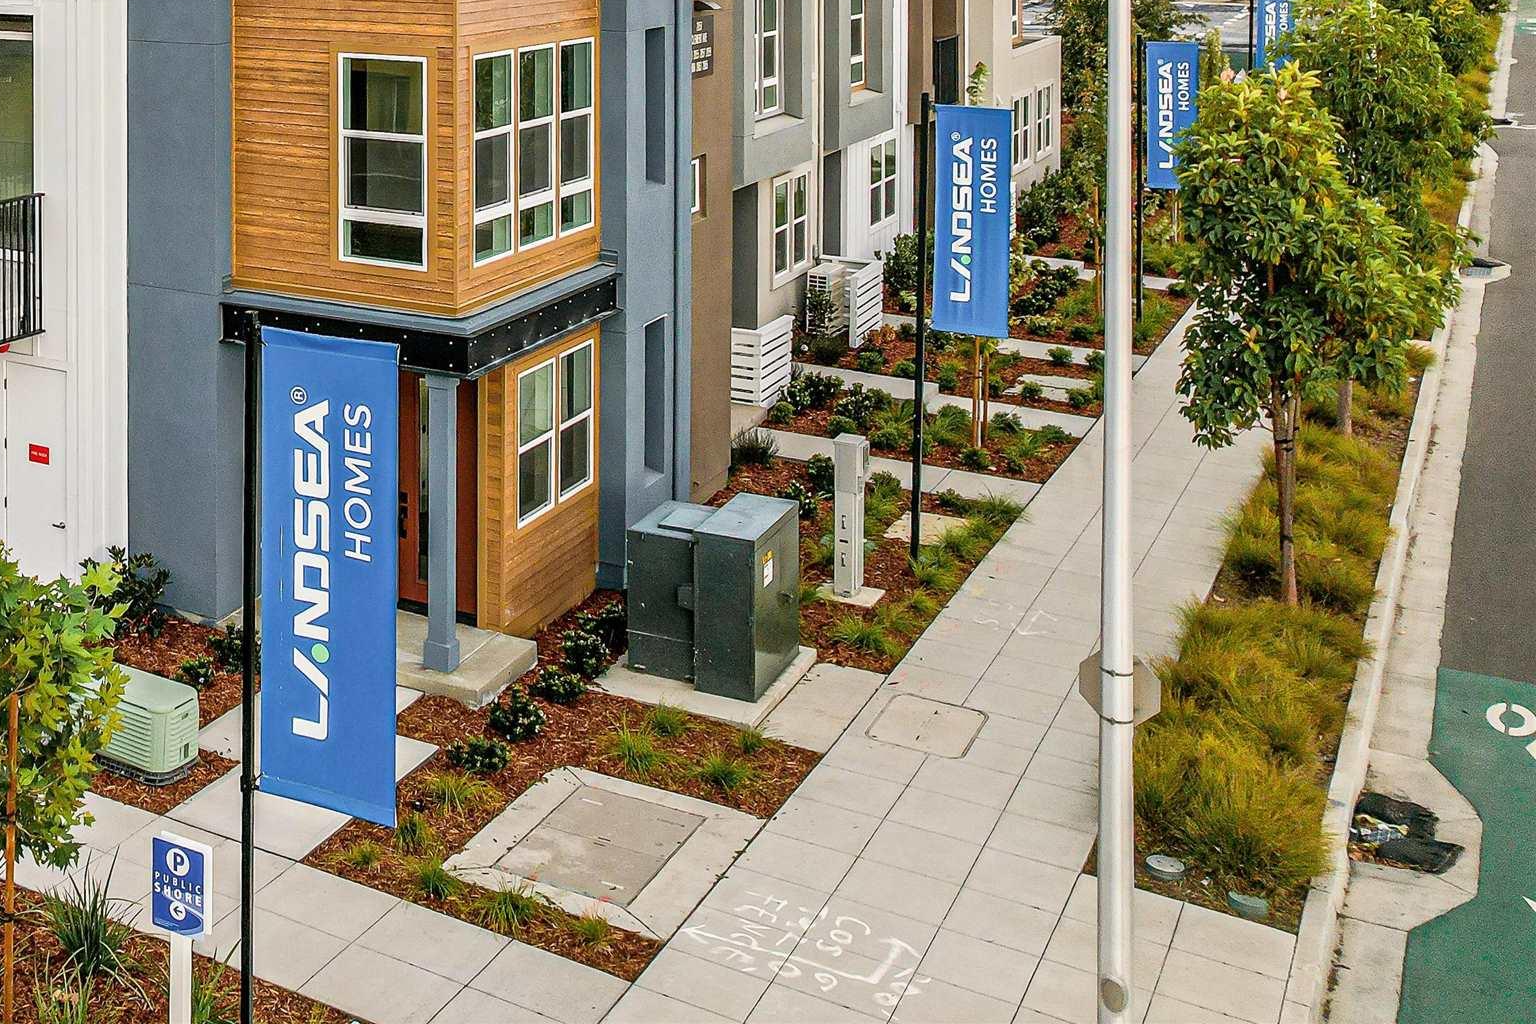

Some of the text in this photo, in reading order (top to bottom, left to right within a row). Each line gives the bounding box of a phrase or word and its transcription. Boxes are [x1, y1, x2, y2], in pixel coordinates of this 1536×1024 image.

[1279, 2, 1289, 31] OMES
[1177, 61, 1189, 112] HOMES
[979, 137, 999, 214] HOMES
[343, 402, 373, 563] HOMES
[154, 871, 201, 895] PUBLIC
[154, 882, 202, 907] SHORE
